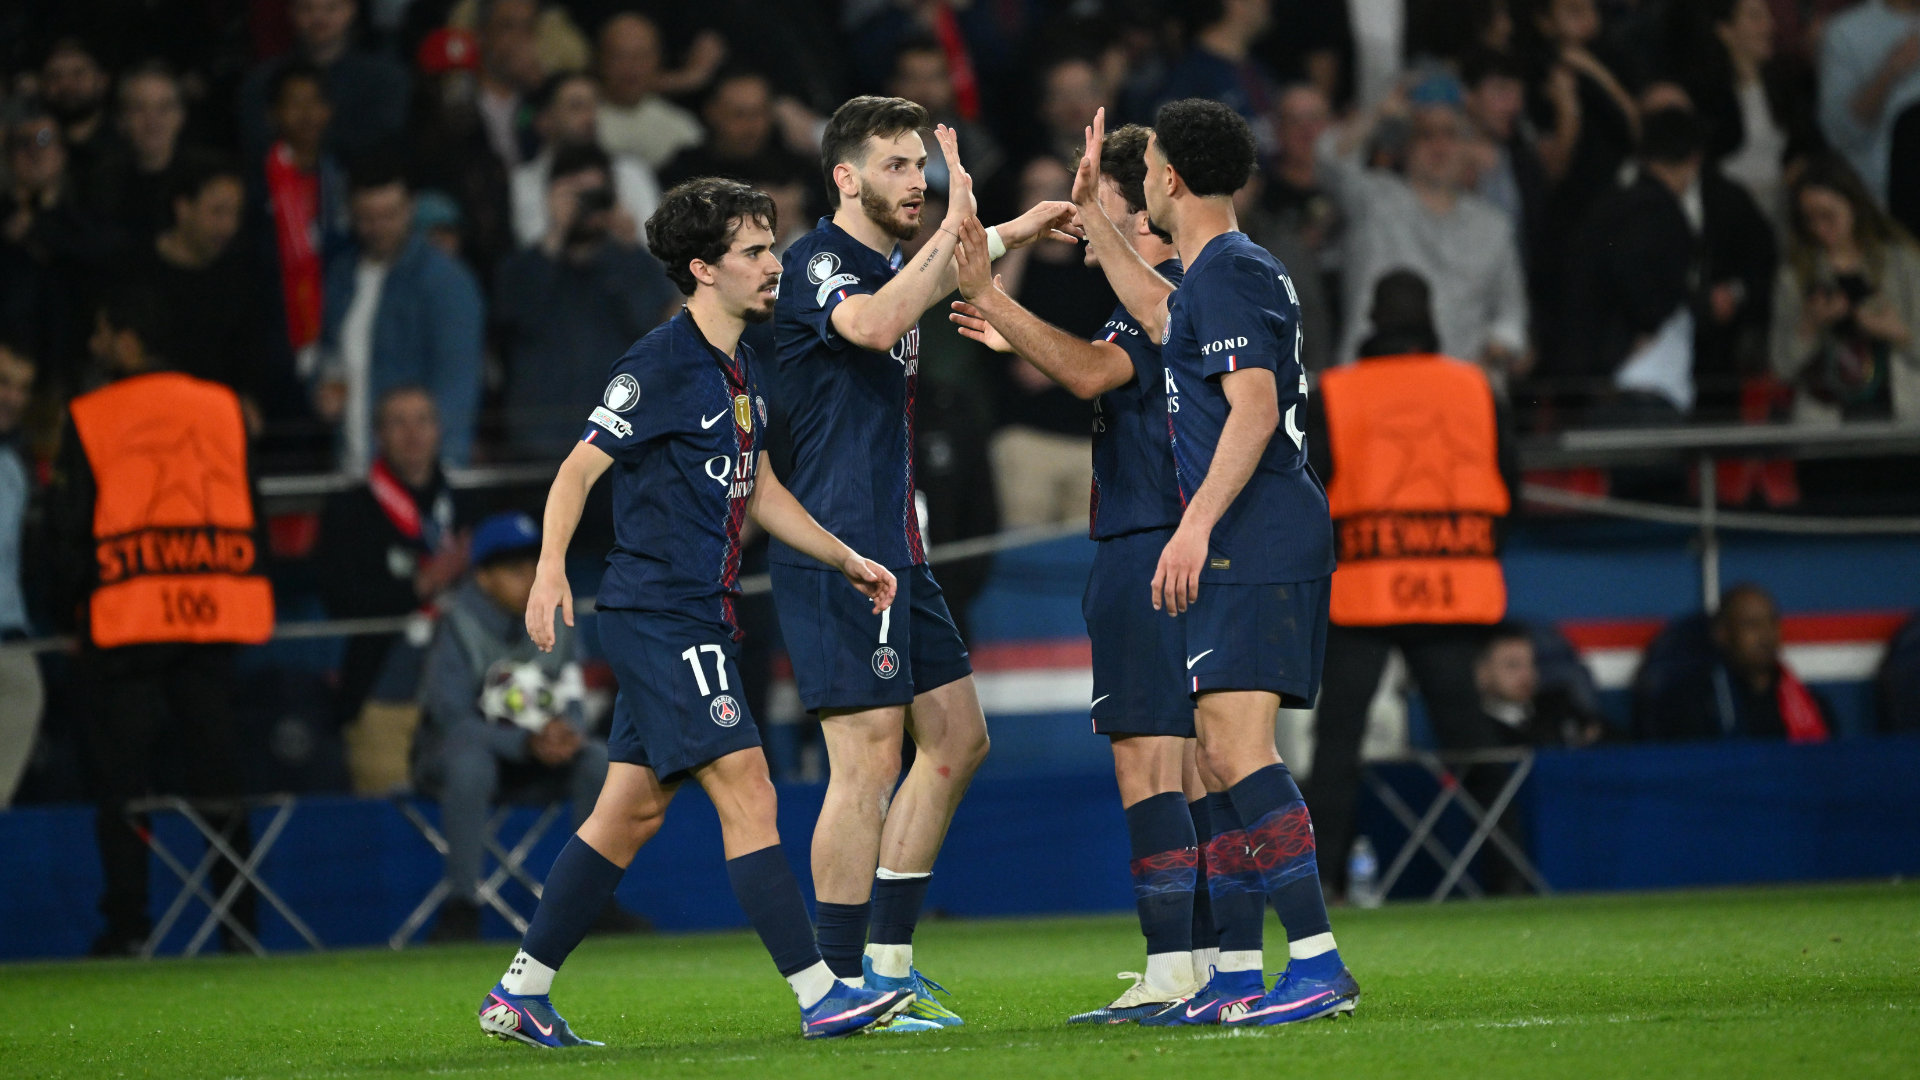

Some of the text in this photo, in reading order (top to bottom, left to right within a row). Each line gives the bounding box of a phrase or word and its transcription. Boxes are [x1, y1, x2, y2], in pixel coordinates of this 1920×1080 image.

[1201, 336, 1249, 356] YOND
[96, 531, 256, 582] STEWARD
[682, 644, 729, 697] 17
